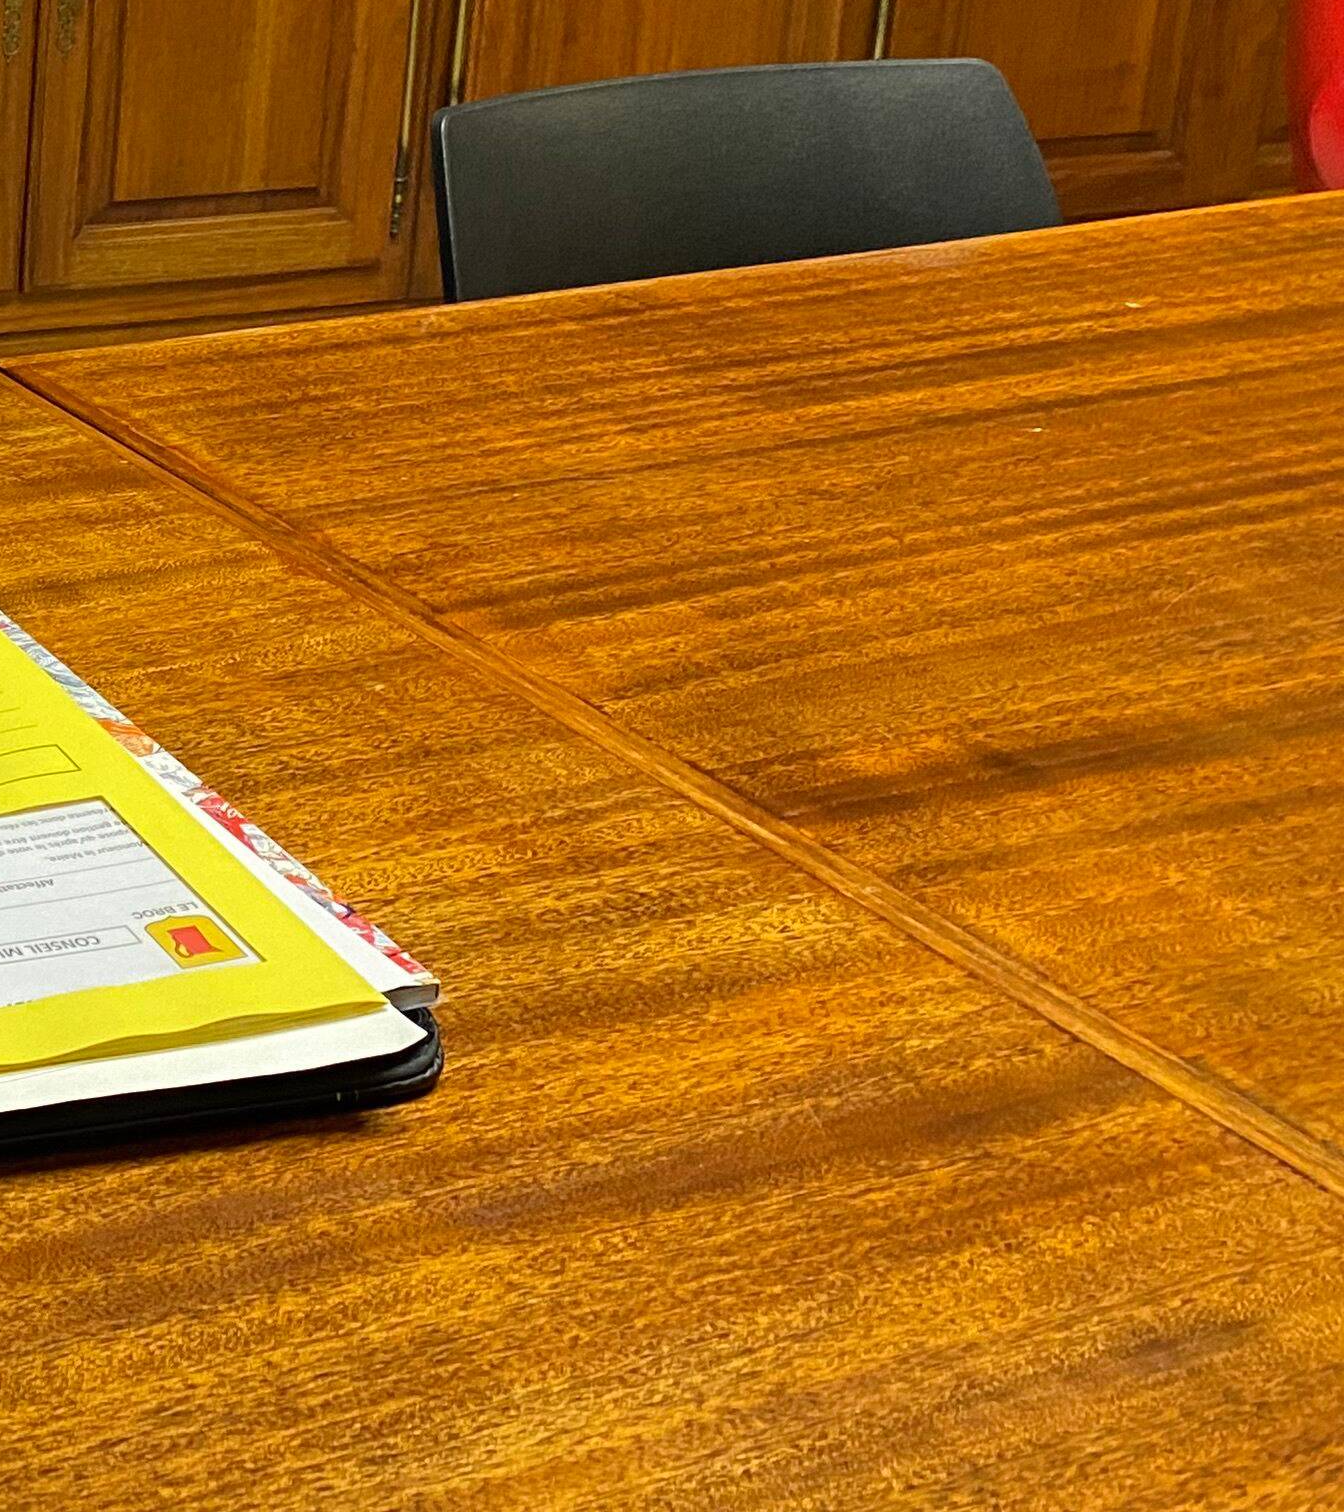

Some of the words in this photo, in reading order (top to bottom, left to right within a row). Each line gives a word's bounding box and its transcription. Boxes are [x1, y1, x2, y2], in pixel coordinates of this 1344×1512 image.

[130, 906, 177, 920] BROC
[176, 902, 199, 911] LE
[24, 936, 101, 954] CONSEIL
